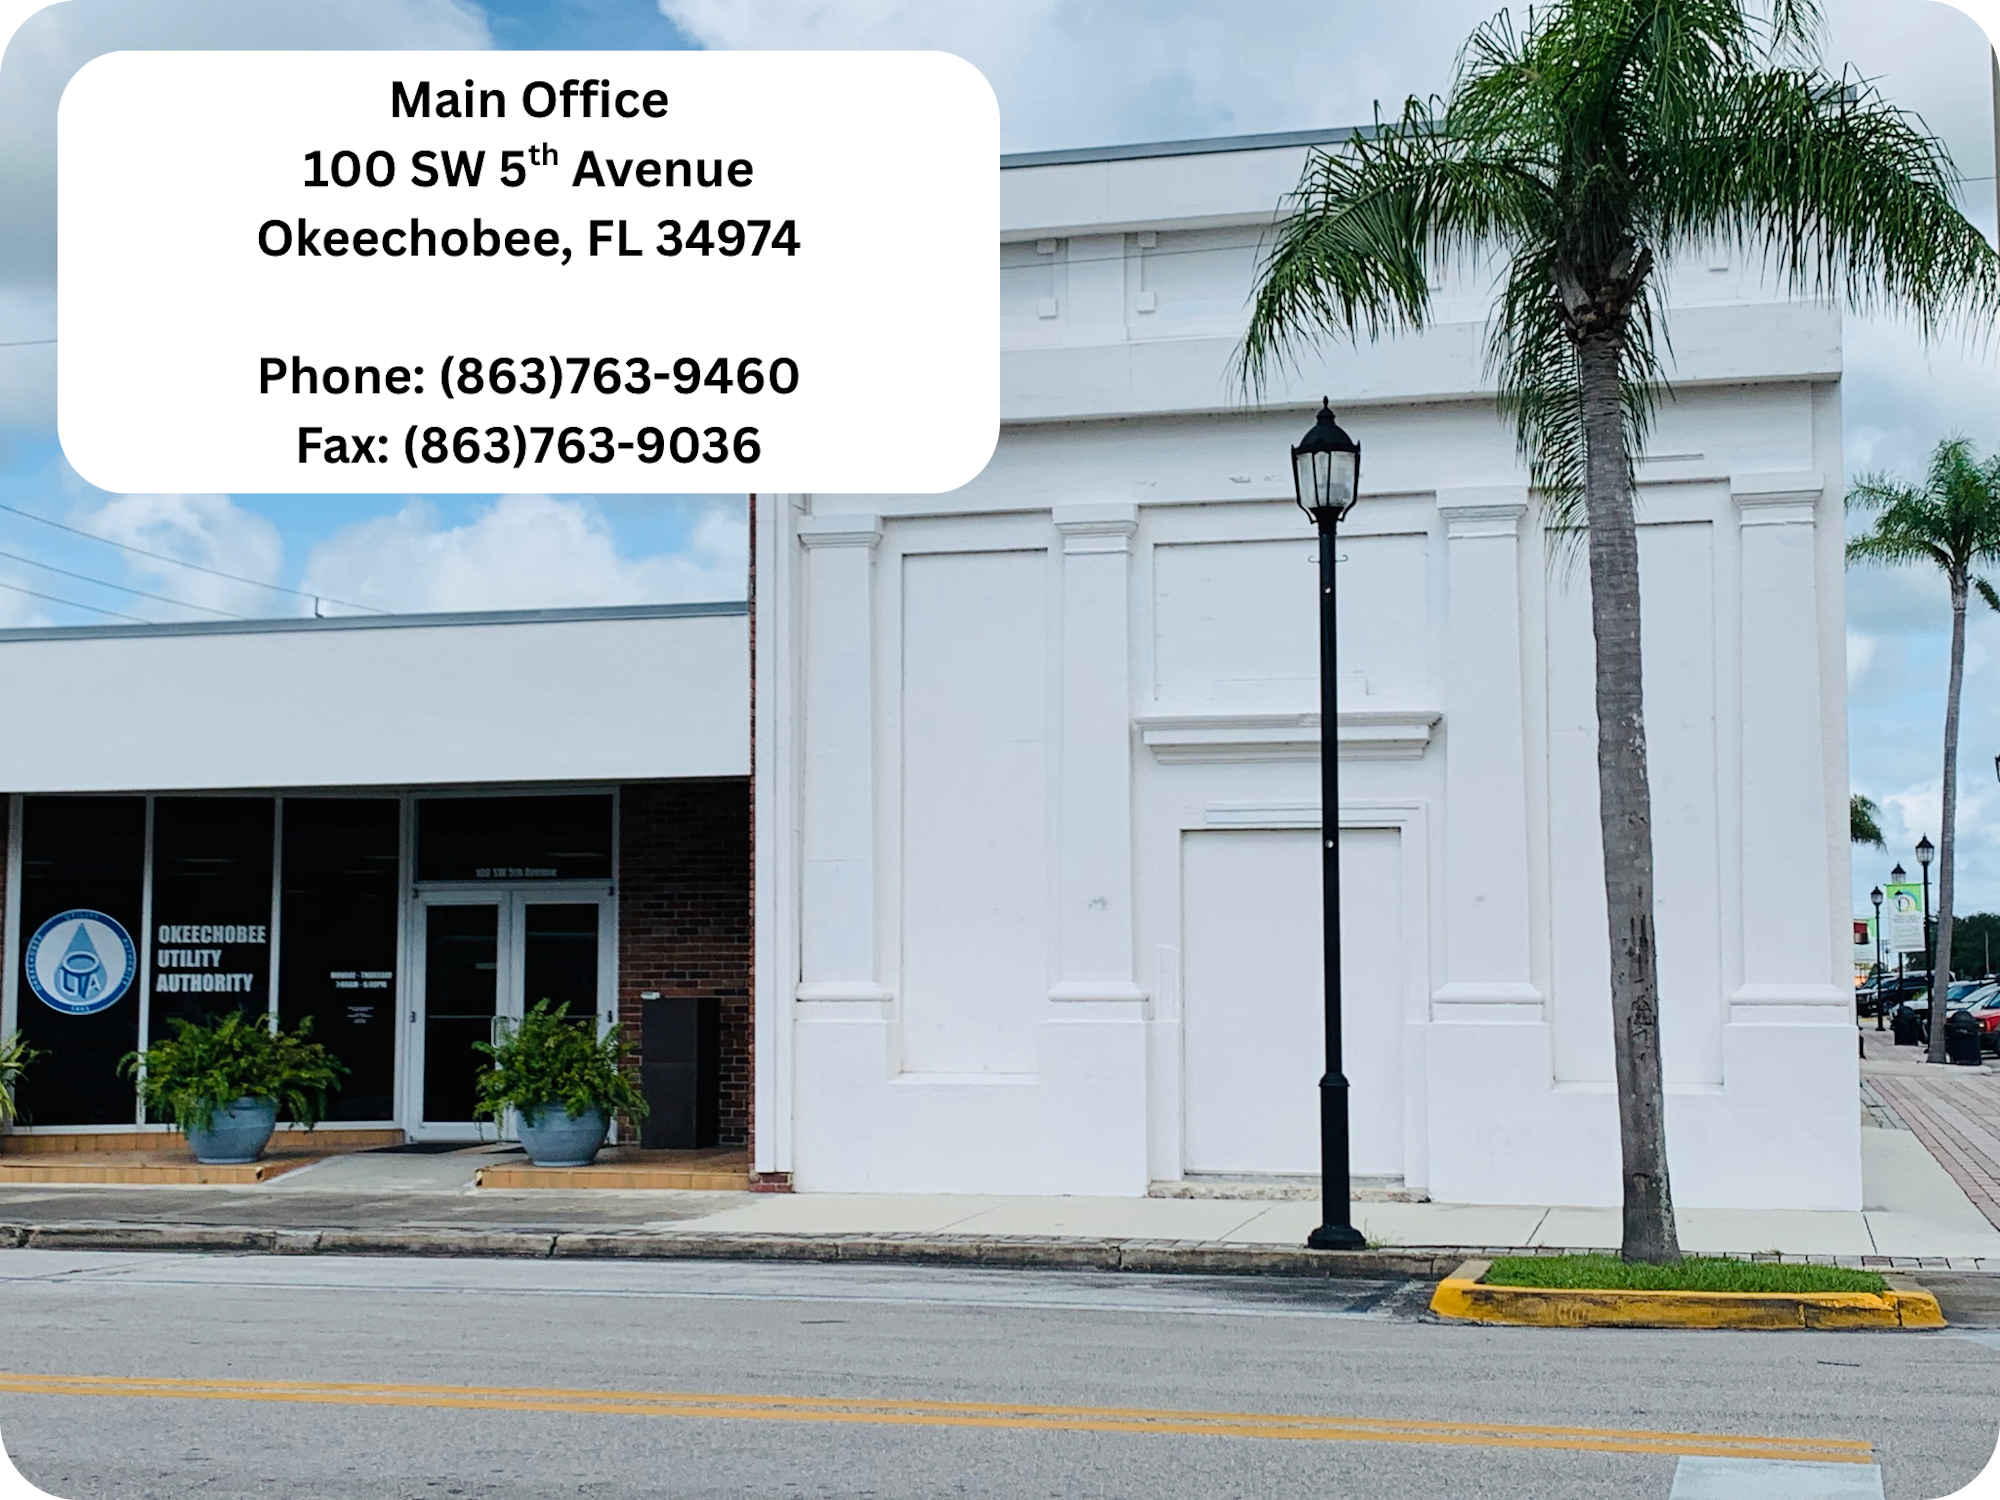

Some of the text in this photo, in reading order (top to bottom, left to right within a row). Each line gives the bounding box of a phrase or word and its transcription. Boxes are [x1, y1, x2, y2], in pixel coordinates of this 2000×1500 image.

[158, 925, 266, 944] OKEECHOBEE
[157, 949, 222, 968] UTILITY
[156, 973, 254, 992] AUTHORITY
